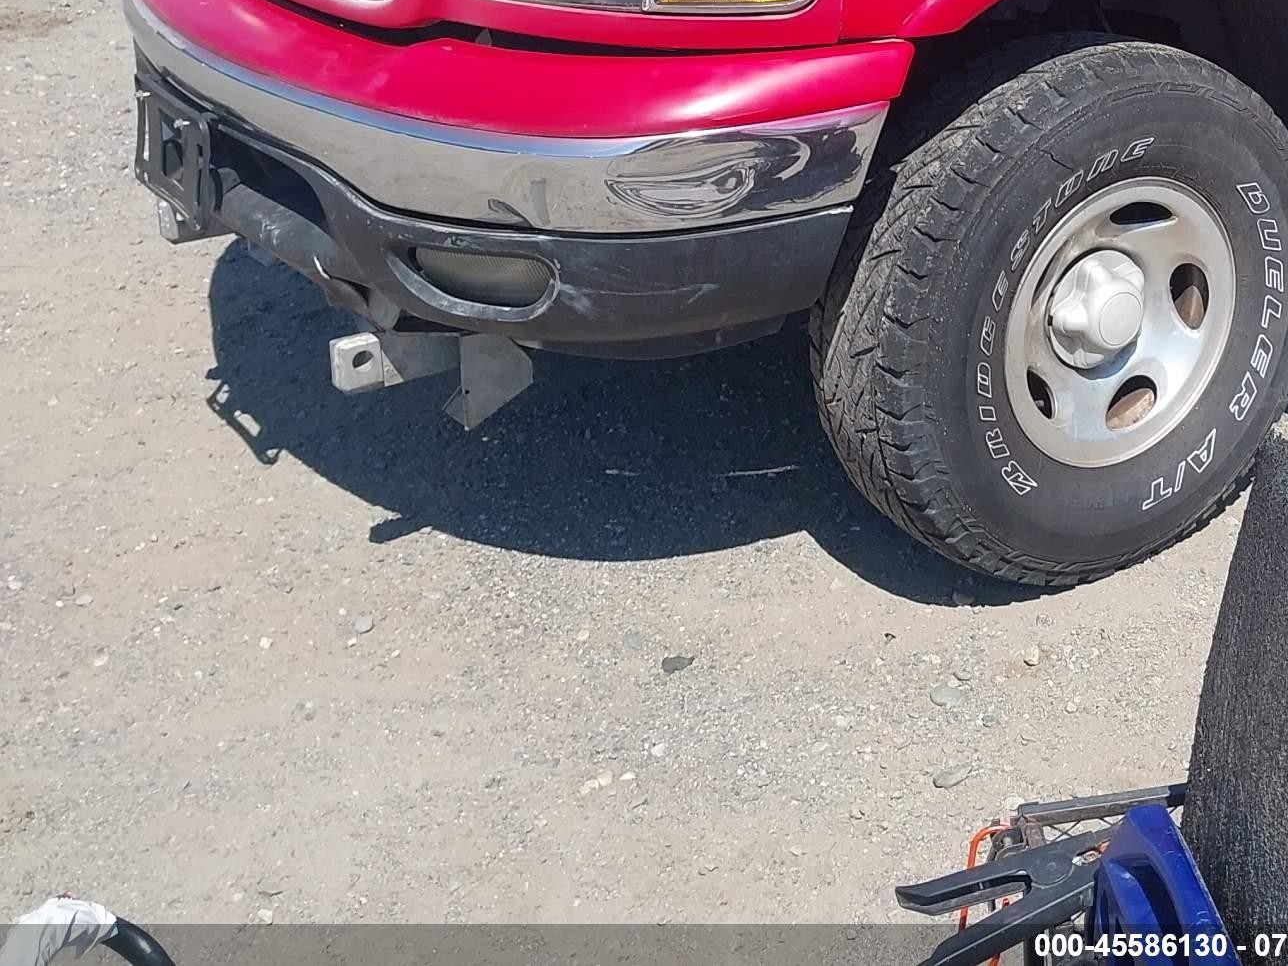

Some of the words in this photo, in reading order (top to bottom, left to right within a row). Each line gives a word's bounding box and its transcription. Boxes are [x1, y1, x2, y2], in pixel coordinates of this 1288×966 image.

[977, 136, 1155, 498] BRIDGESTONE
[1229, 181, 1284, 423] DUELER
[1141, 428, 1216, 510] A/T
